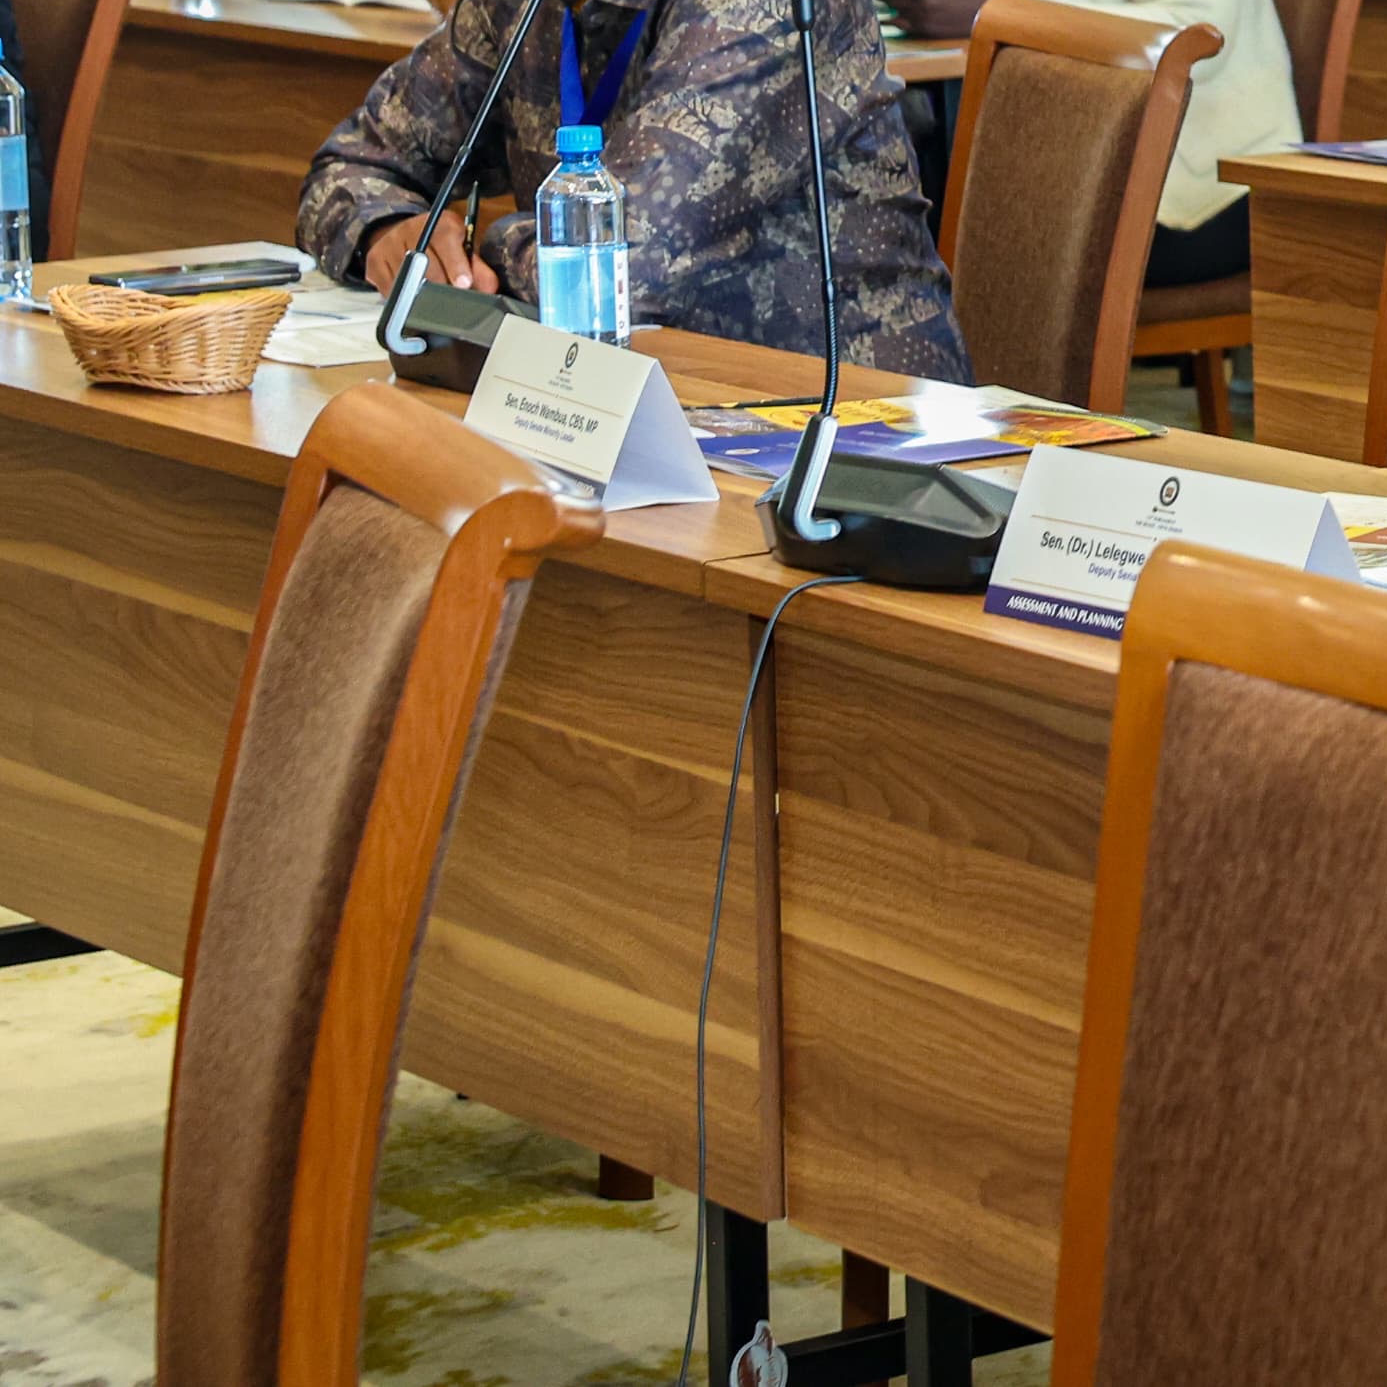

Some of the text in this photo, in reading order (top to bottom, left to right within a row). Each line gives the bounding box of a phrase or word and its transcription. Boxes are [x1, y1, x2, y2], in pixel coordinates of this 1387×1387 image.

[519, 397, 540, 414] Enoch
[585, 418, 599, 434] MP
[1040, 531, 1146, 566] Sen. (Dr.) Lelegwe
[1088, 563, 1137, 582] Deputy Sena
[1006, 595, 1124, 631] ASSESSMENT AND PLANNING
